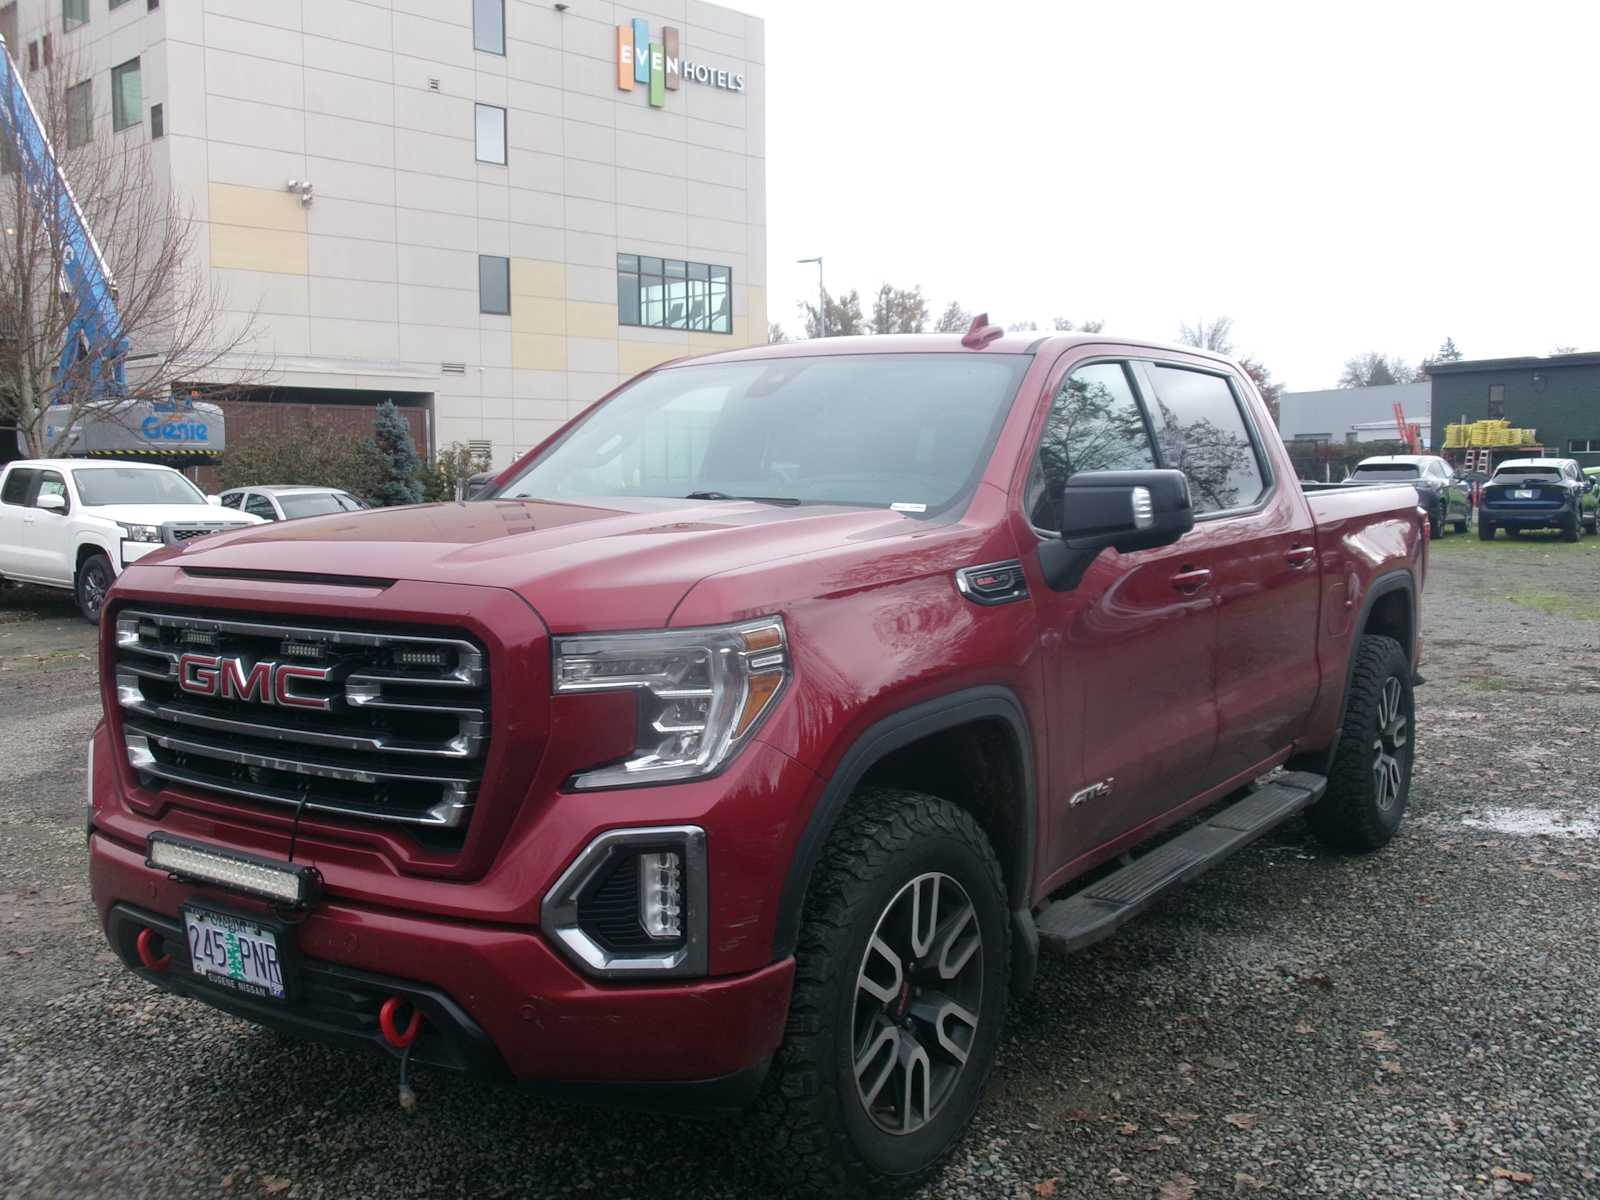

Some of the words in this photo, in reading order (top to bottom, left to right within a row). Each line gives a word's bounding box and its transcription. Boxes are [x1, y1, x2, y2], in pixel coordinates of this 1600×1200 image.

[621, 44, 679, 75] EVEN
[682, 60, 745, 91] HOTELS
[143, 415, 208, 440] Genie
[178, 653, 332, 711] GMC
[190, 925, 227, 967] 245
[238, 937, 281, 985] PNR
[239, 983, 266, 998] NISSAN
